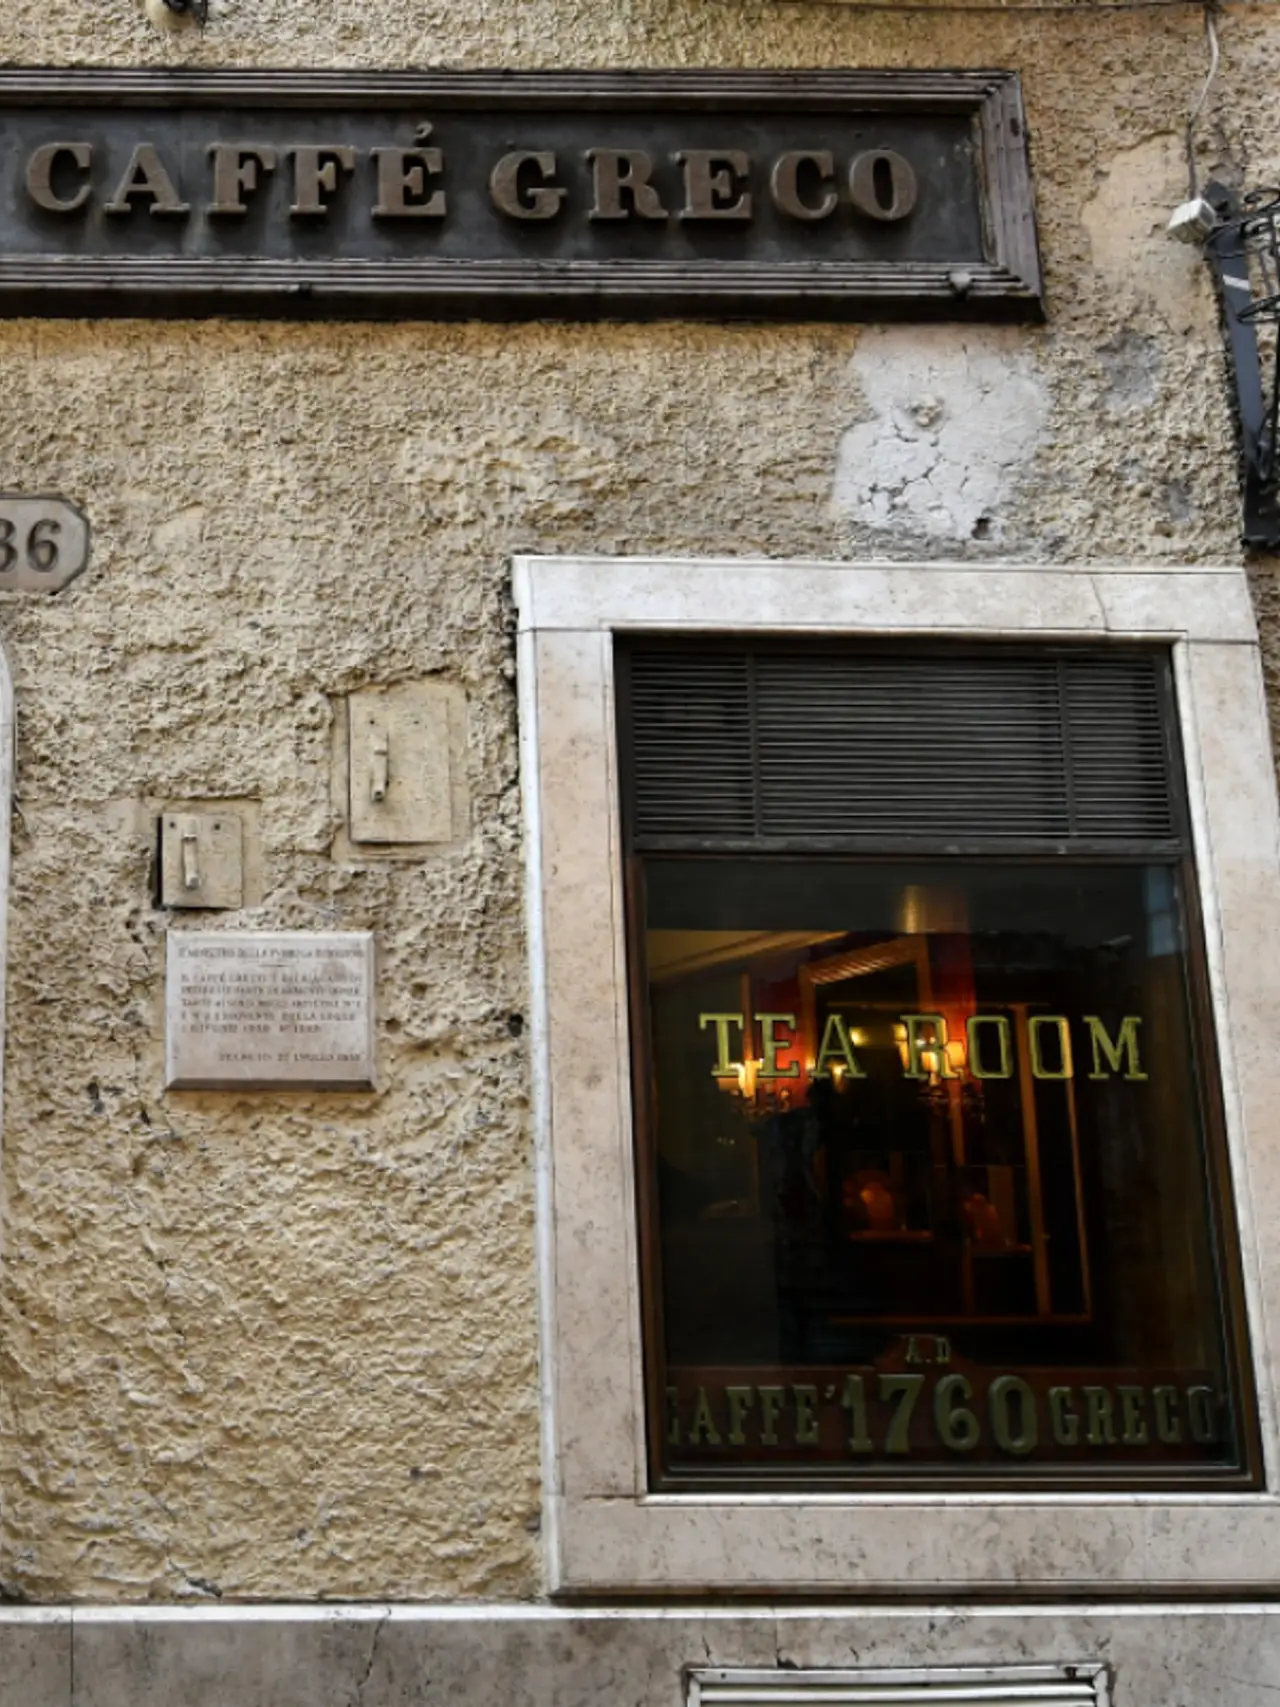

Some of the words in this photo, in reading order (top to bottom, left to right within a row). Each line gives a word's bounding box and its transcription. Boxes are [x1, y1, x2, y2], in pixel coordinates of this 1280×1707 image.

[25, 120, 447, 217] CAFFÉ
[488, 146, 919, 222] GRECO
[698, 1012, 868, 1080] TEA
[901, 1013, 1150, 1082] ROOM
[842, 1373, 1040, 1455] 1760
[1047, 1384, 1219, 1447] GRECO
